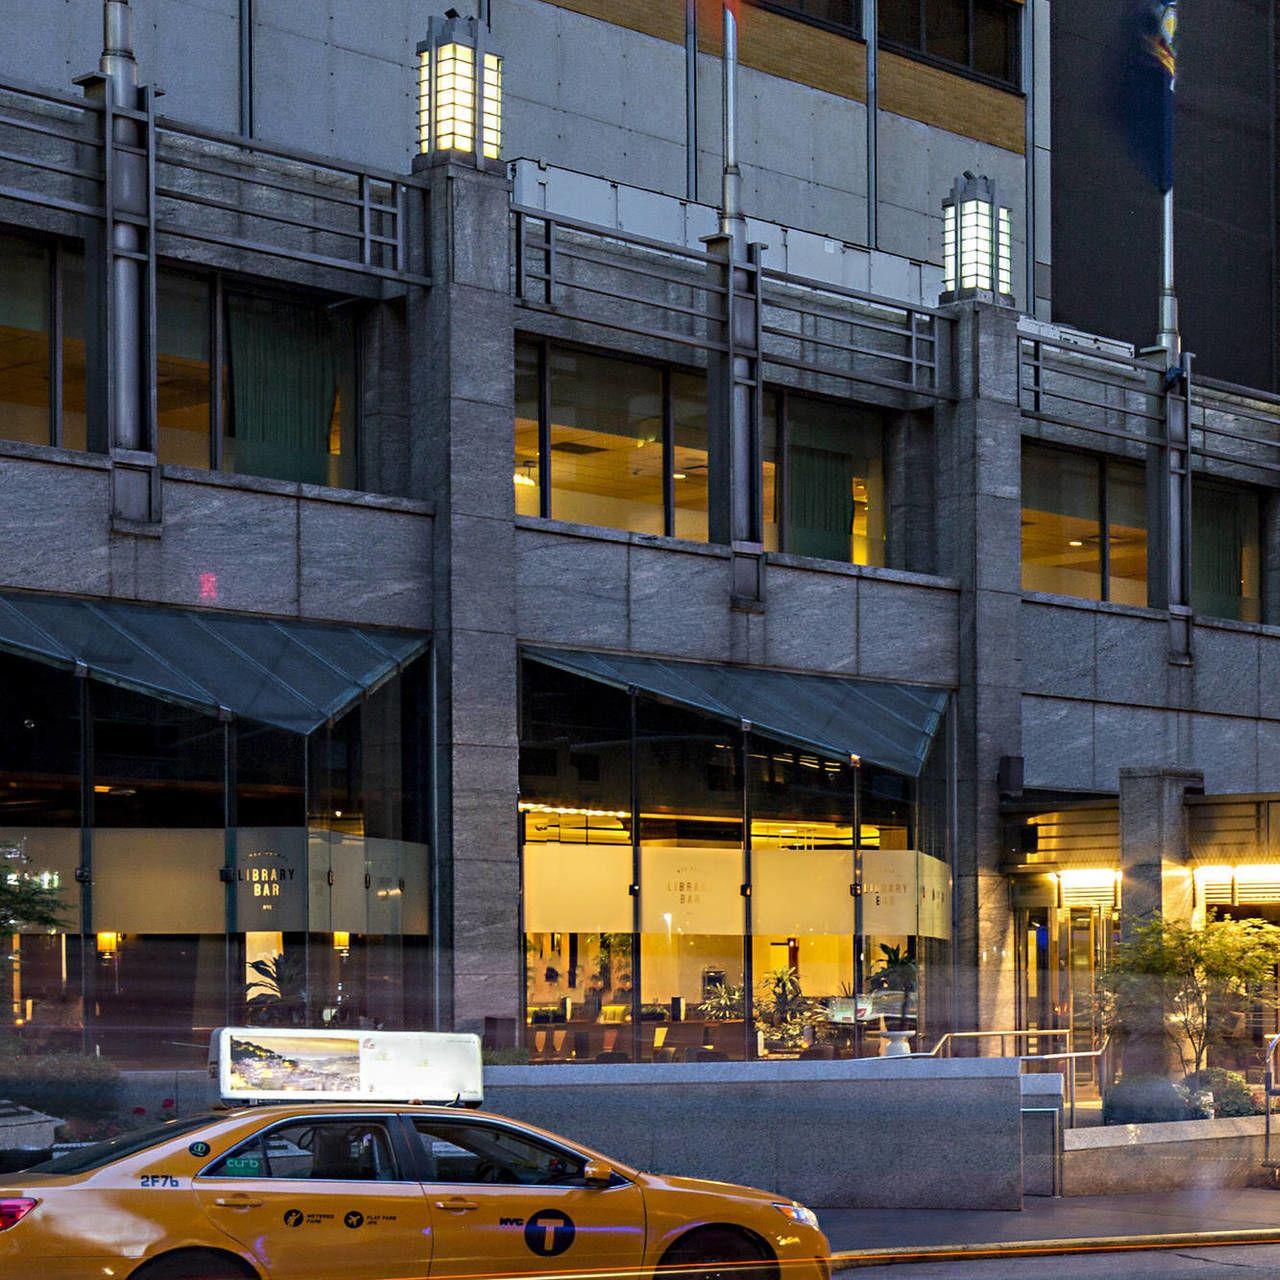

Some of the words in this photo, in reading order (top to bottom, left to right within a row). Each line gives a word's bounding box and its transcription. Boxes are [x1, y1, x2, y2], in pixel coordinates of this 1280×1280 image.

[238, 868, 295, 881] LIBRARY
[253, 883, 280, 897] BAR
[500, 1217, 524, 1226] NYC
[537, 1218, 564, 1251] T
